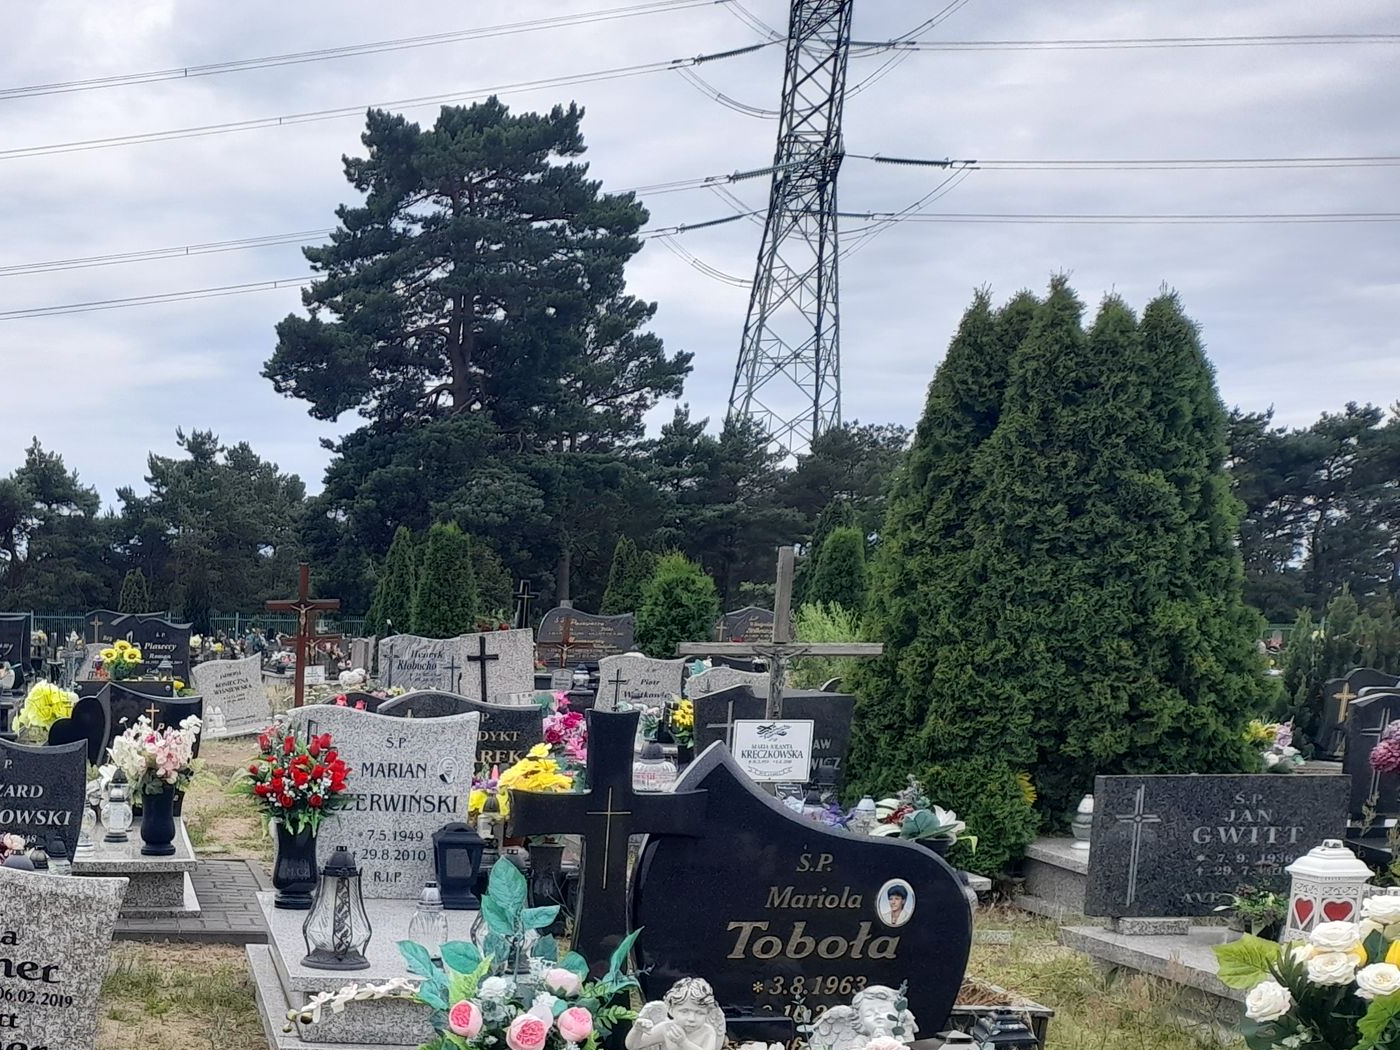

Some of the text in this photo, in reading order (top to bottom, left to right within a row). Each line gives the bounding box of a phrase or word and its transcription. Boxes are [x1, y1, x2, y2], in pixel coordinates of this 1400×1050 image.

[361, 762, 428, 780] MARIAN
[1223, 808, 1273, 823] JAN
[366, 829, 424, 843] 7.5.1949
[1191, 826, 1304, 844] GWITT
[360, 848, 427, 862] 29.8.2010
[795, 844, 834, 872] Ś.P.
[373, 871, 402, 883] R.I.P.
[764, 886, 863, 909] Mariola
[726, 920, 901, 960] Toboła
[768, 975, 868, 996] 3.8.1963
